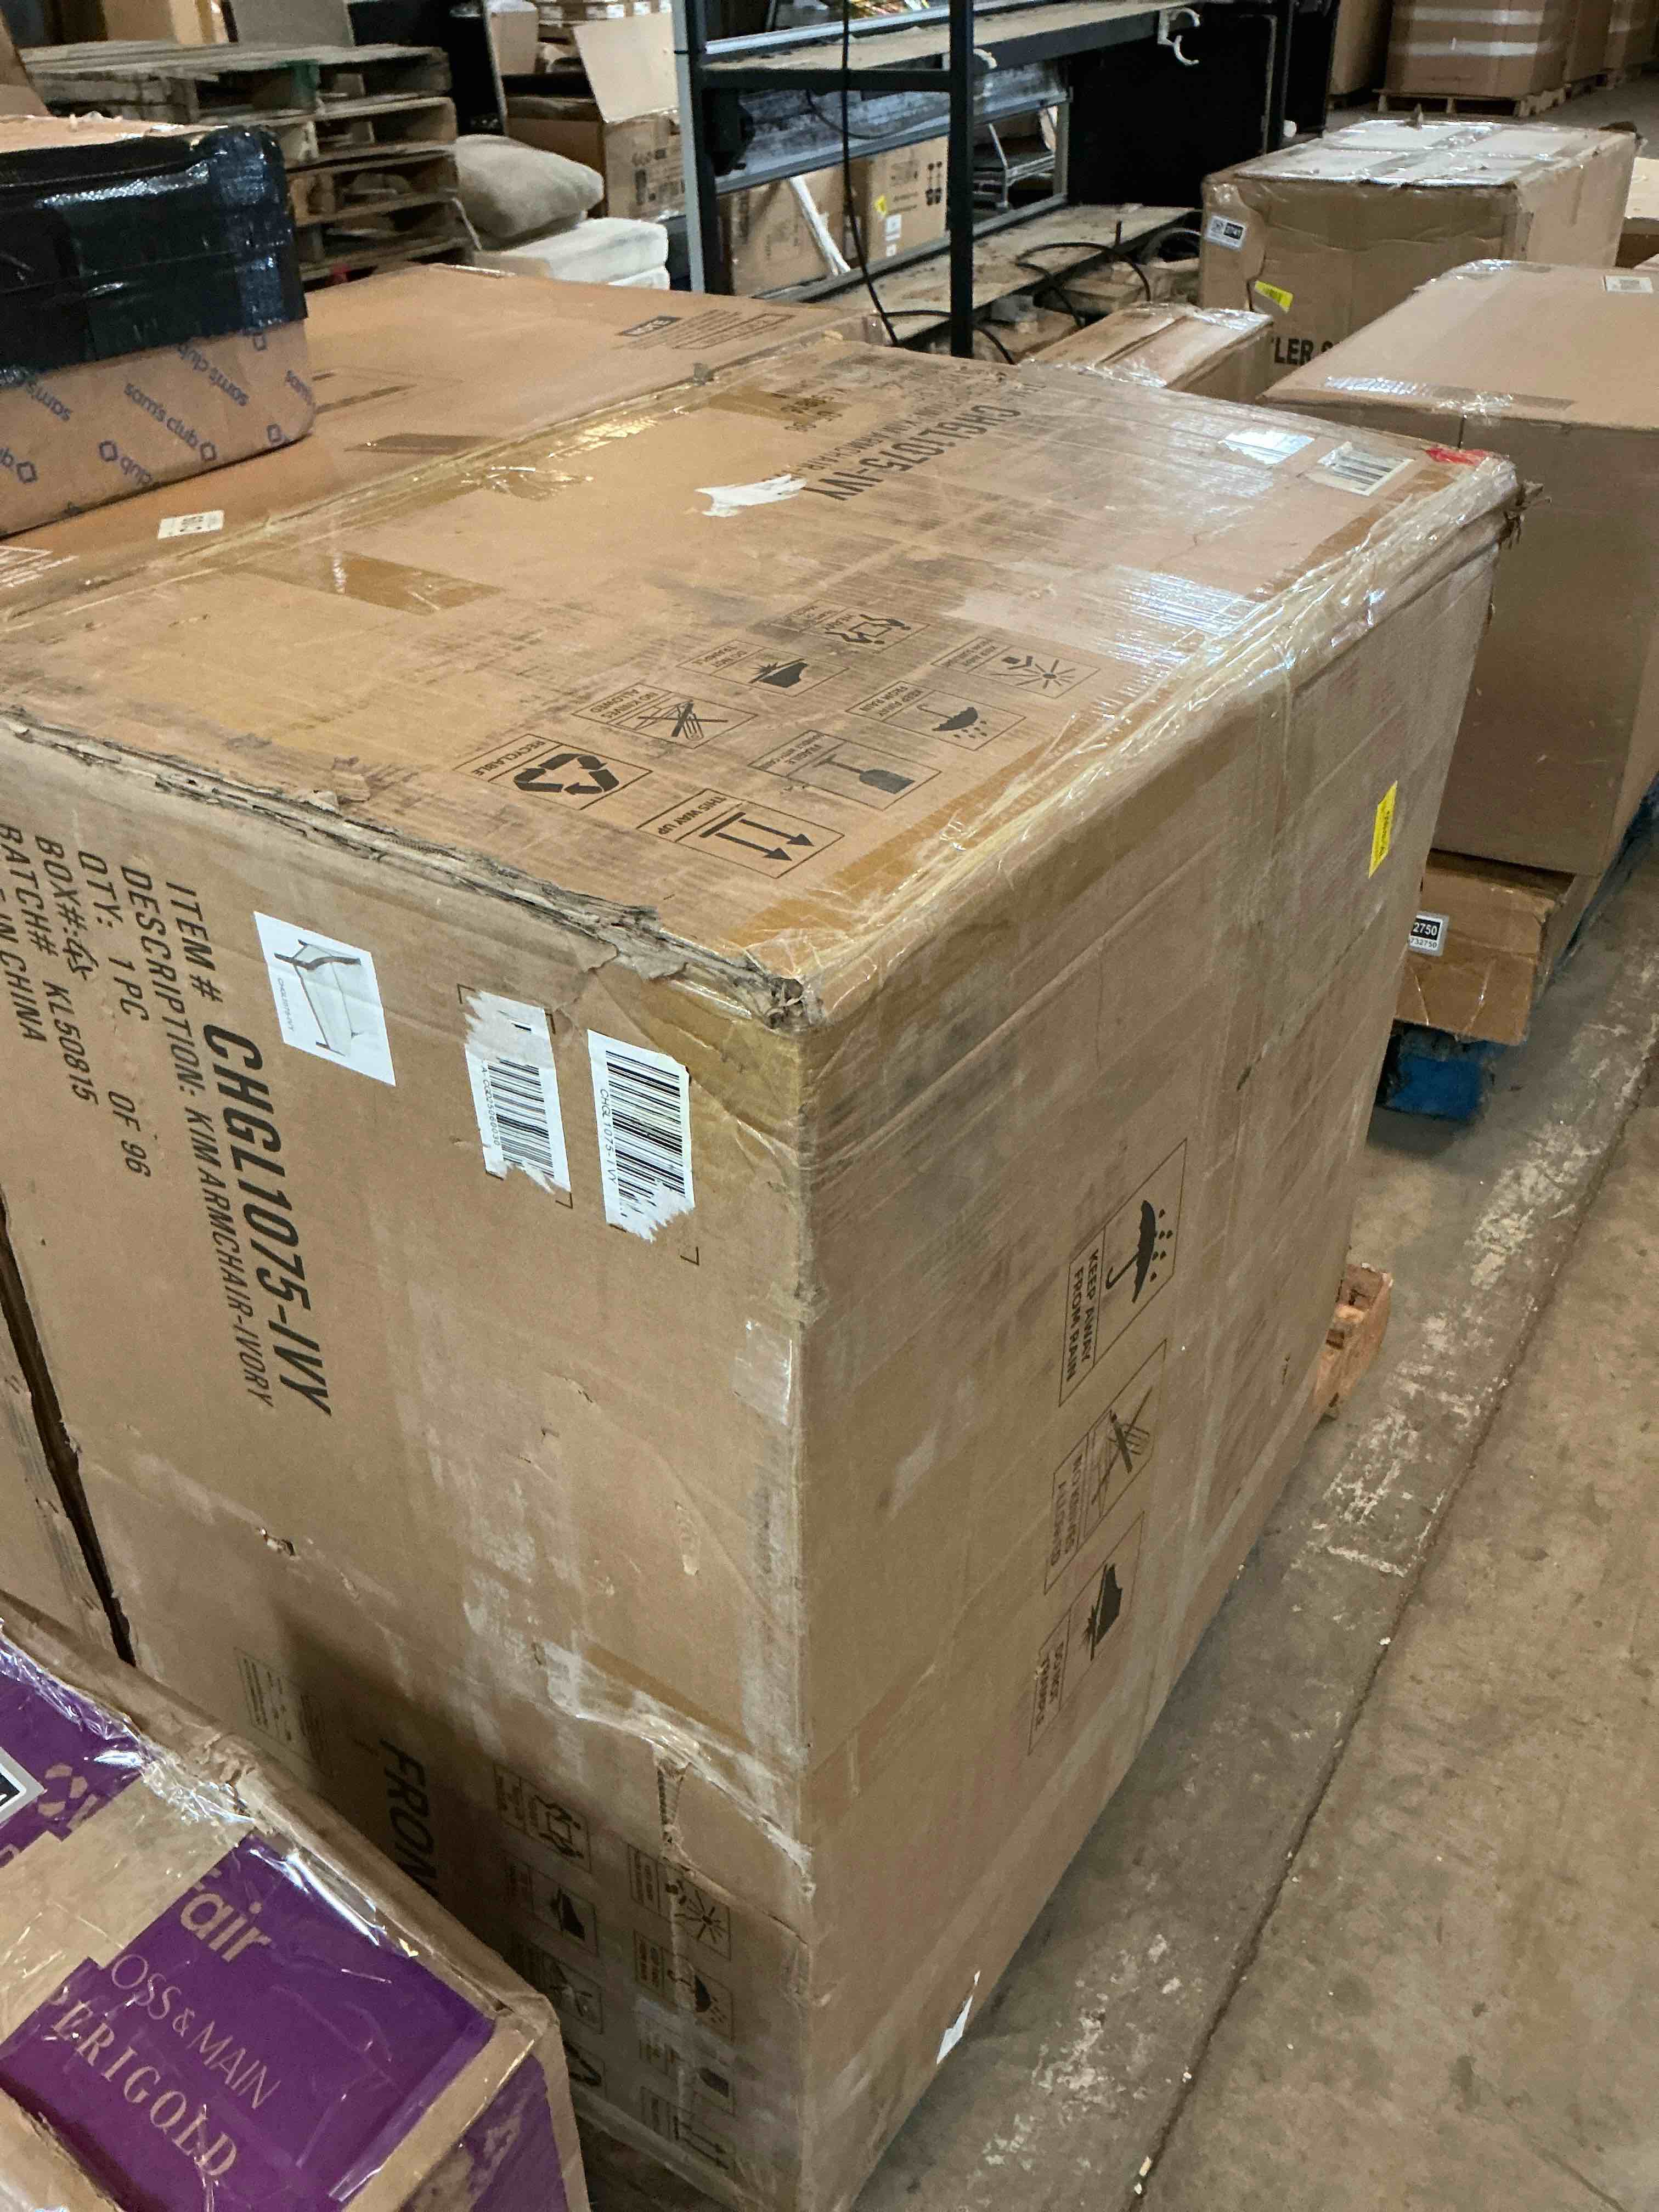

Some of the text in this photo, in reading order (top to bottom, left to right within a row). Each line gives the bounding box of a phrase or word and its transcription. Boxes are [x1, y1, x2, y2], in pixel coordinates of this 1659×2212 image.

[1271, 337, 1314, 366] LER
[471, 741, 546, 776] RECYCLABLE
[657, 796, 727, 835] THIS WAY UP
[35, 834, 88, 937] BOX#:
[77, 850, 123, 928] QTY:
[1413, 922, 1437, 936] 2750
[0, 825, 98, 1105] BATCH# KL50815
[0, 950, 48, 1042] CHINA
[108, 1090, 152, 1178] OF 96
[119, 865, 273, 1408] DESCRIPTION: KIM ARMCHAIR-IVORY
[166, 881, 332, 1417] ITEM # CHGL1075-IVY
[1066, 1266, 1084, 1383] FROM RAIN
[1081, 1248, 1098, 1362] KEEP AWAY
[379, 1737, 440, 1899] FRON
[50, 1985, 236, 2177] ERIGOLD
[111, 1954, 283, 2112] OSS & MAIN
